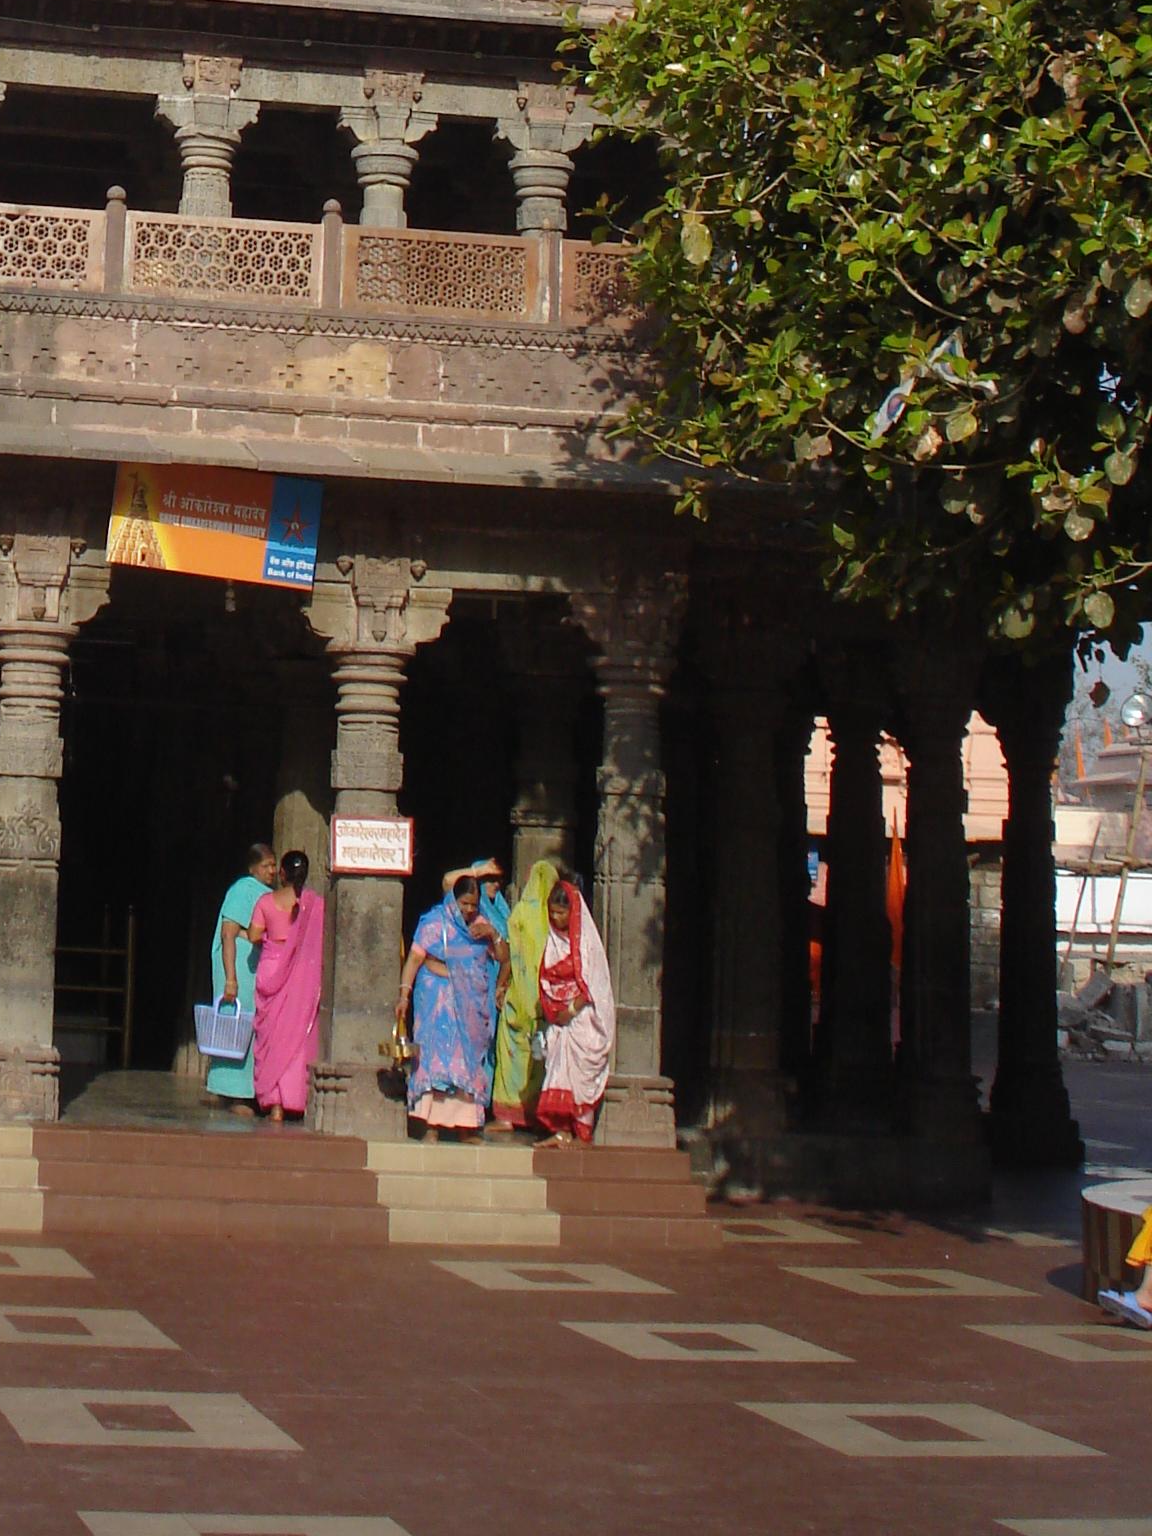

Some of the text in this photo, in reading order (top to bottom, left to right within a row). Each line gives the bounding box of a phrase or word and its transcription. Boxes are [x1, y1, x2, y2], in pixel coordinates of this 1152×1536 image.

[163, 490, 177, 509] श्री
[233, 501, 268, 521] महादेव
[267, 567, 314, 582] Bank of India
